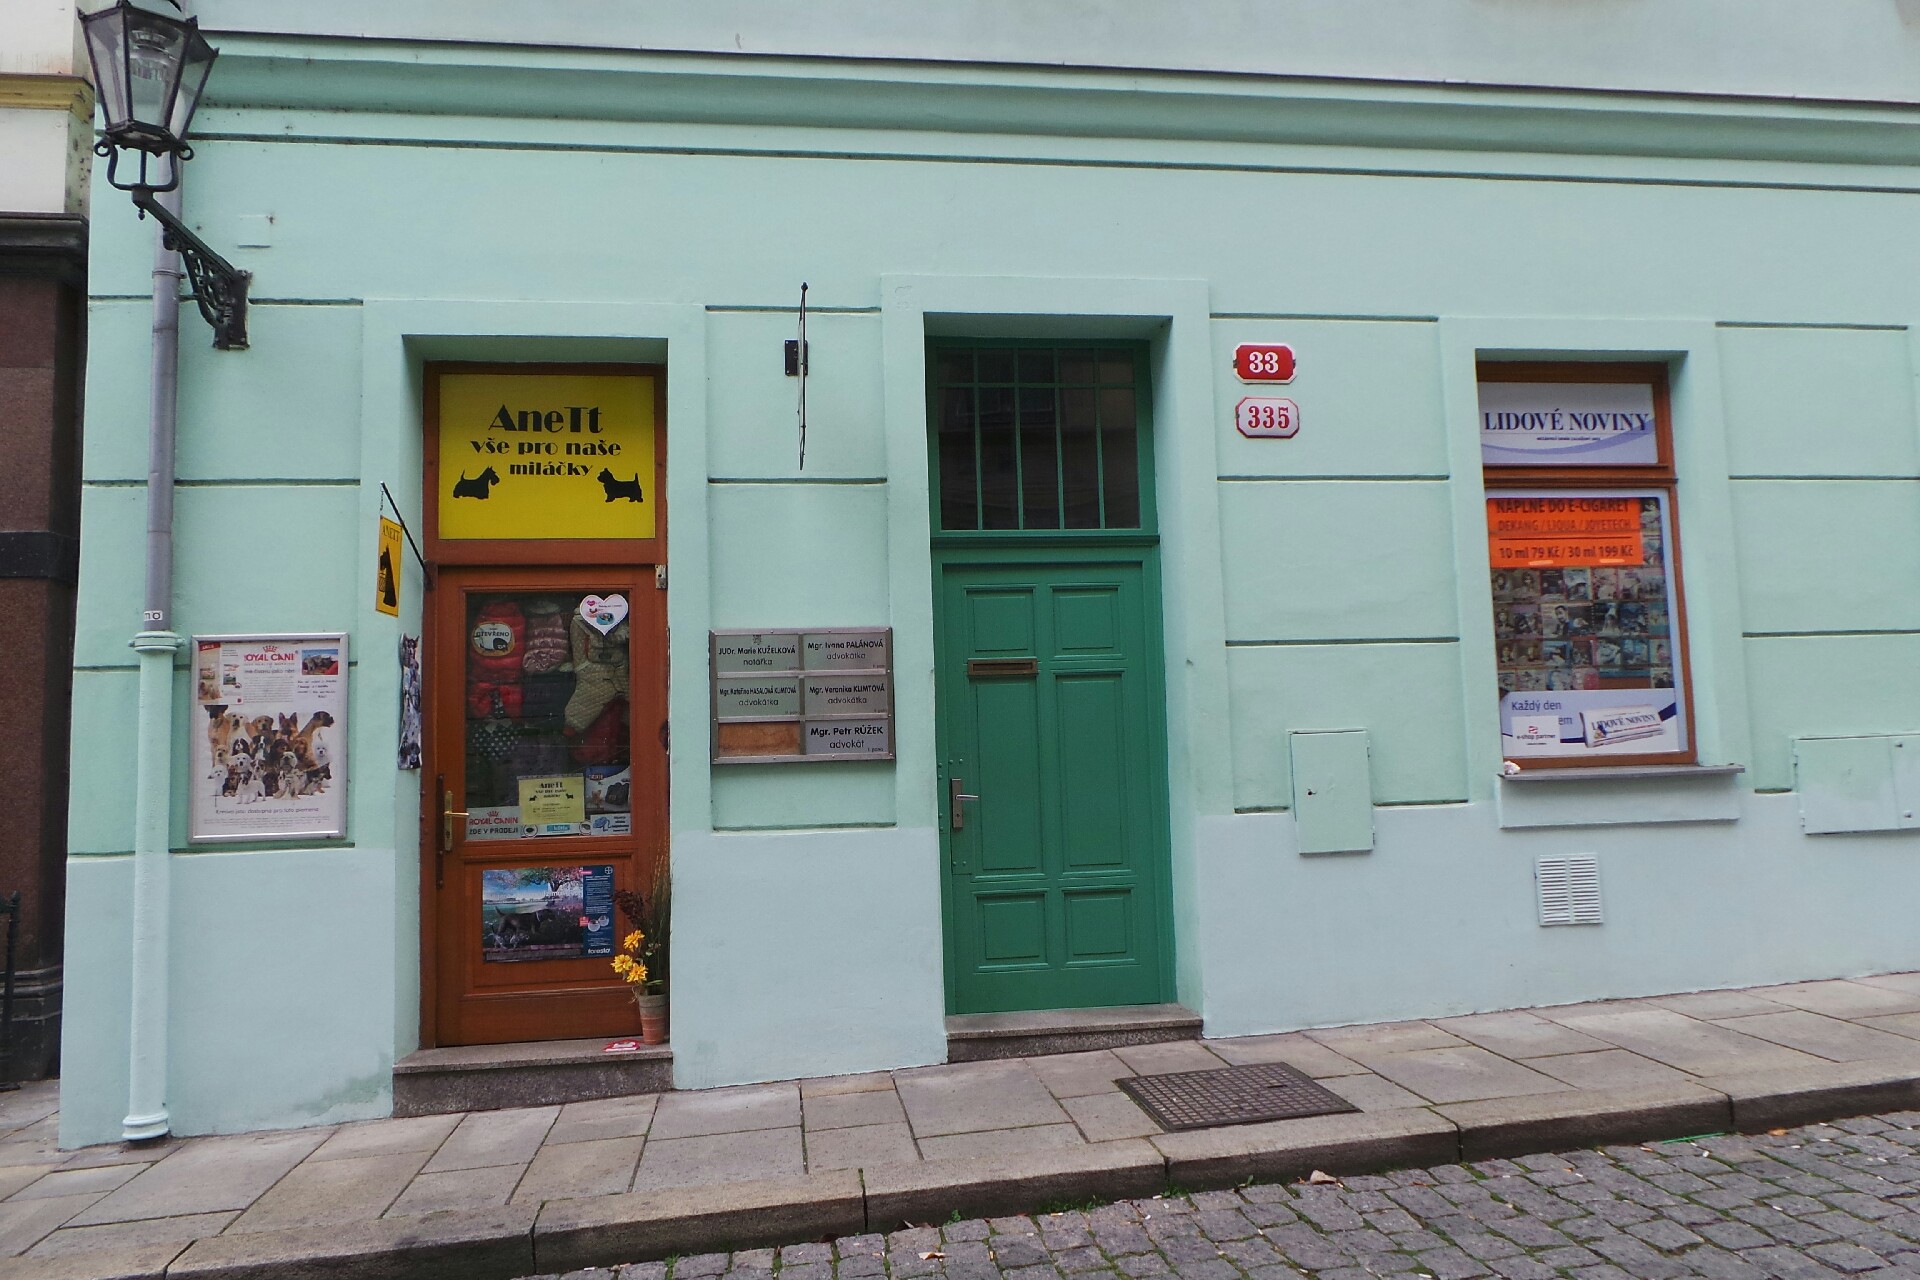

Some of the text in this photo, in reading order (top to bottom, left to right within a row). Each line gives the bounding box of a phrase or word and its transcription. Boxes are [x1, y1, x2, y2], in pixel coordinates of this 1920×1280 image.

[1249, 351, 1279, 374] 33
[488, 404, 604, 433] AneTt
[1248, 405, 1290, 429] 335
[1484, 408, 1649, 431] LIDOVÉ NOVINY
[470, 437, 622, 456] vše pro naše
[509, 461, 593, 476] miláčky
[1499, 547, 1513, 559] 10
[1515, 546, 1529, 558] ml
[1531, 546, 1545, 558] 79
[1547, 545, 1560, 558] Kč
[1568, 546, 1581, 558] 30
[1583, 546, 1596, 557] ml
[1598, 546, 1618, 557] 199
[1621, 544, 1634, 557] Kč
[718, 645, 796, 655] JUDr. Marie KUŽELKOVÁ
[807, 638, 884, 651] Mgr. Ivana PALÁNOVÁ
[743, 657, 773, 666] notářka
[826, 652, 866, 660] advokátka
[809, 683, 885, 696] Mgr. Veronika KLIMTOVÁ
[738, 698, 779, 707] advokátka
[827, 696, 867, 705] advokátka
[1511, 700, 1562, 712] Každý den
[810, 724, 884, 738] Mgr. Petr RŮŽEK
[829, 739, 865, 749] advokát
[469, 816, 519, 826] ROYAL CANIN
[469, 827, 482, 835] ZDE
